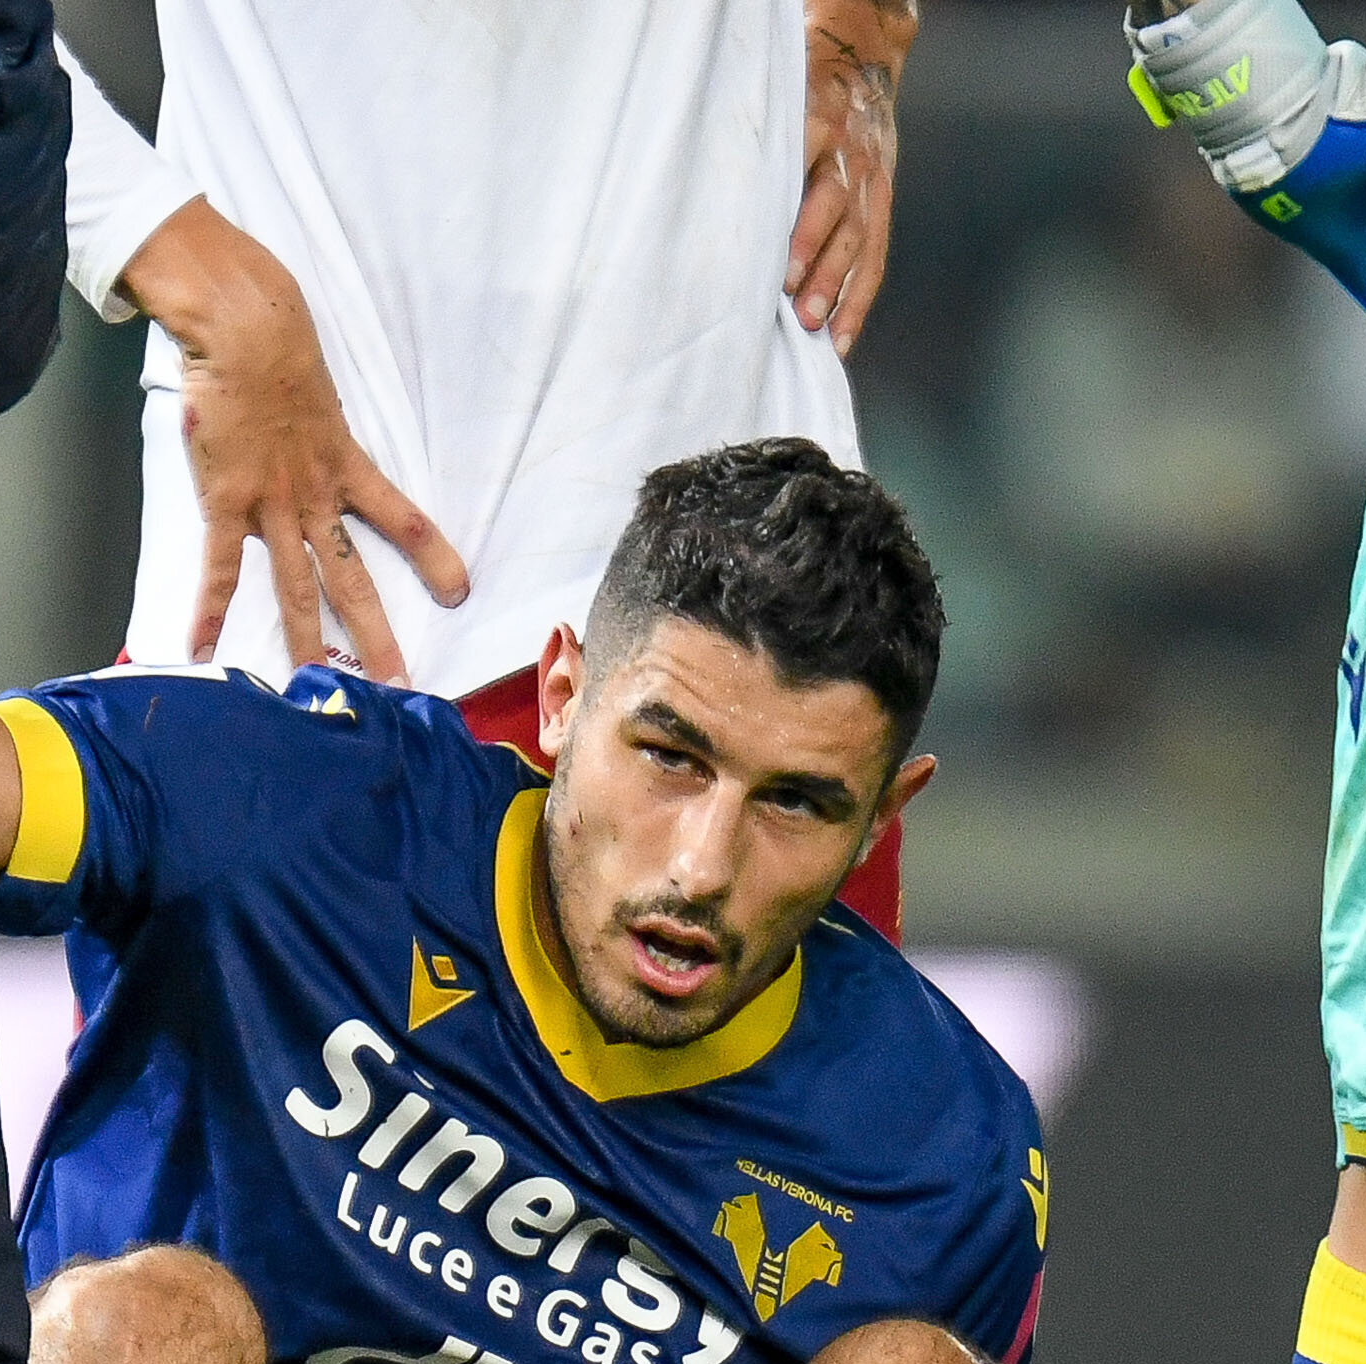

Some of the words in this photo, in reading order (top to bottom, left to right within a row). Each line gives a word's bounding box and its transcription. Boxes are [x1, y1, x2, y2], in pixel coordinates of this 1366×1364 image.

[735, 1158, 781, 1188] HELLAS
[780, 1178, 833, 1216] VERONA
[833, 1204, 855, 1223] FC
[336, 1171, 475, 1293] Luce
[486, 1273, 522, 1319] e
